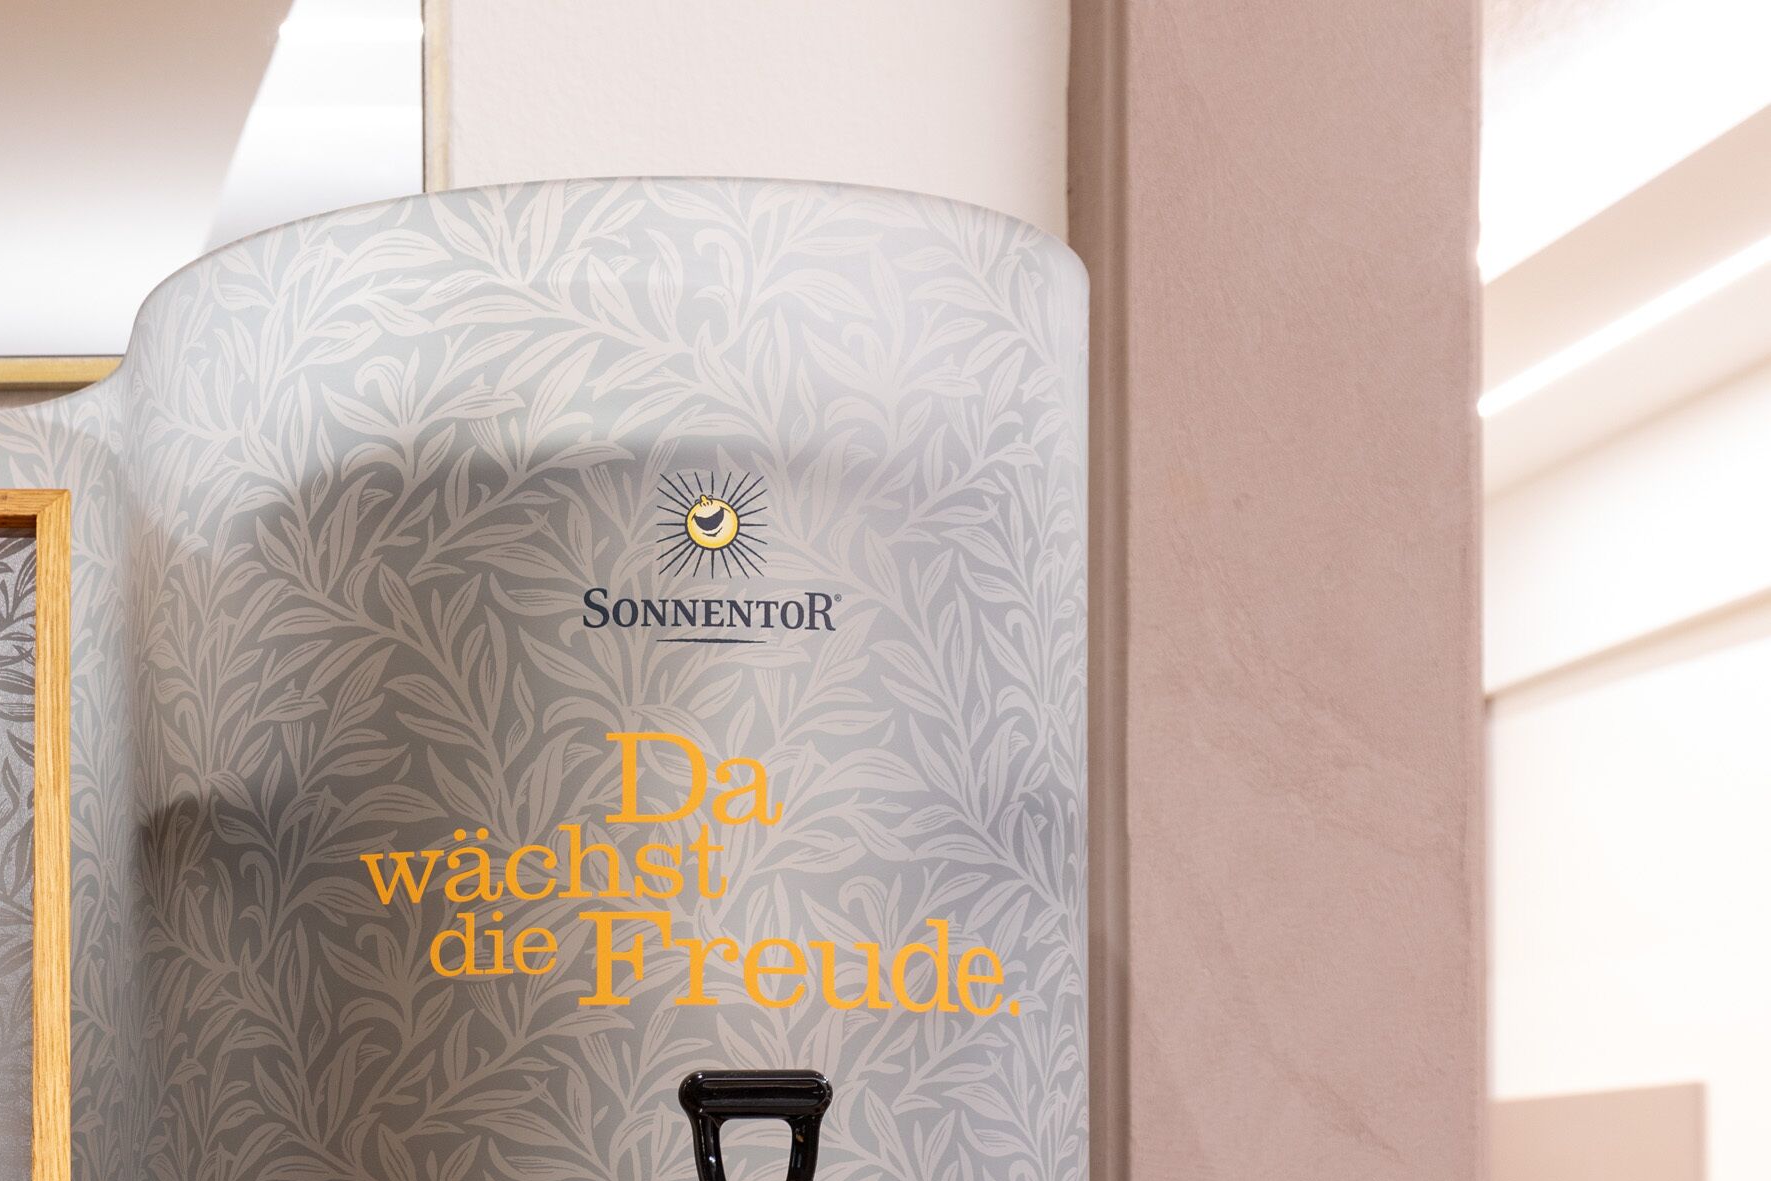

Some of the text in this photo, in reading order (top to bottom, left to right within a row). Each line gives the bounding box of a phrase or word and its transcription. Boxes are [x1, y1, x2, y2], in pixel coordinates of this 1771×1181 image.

[606, 731, 783, 826] Da
[360, 824, 728, 904] wächst
[429, 911, 1020, 1017] die Freude.
